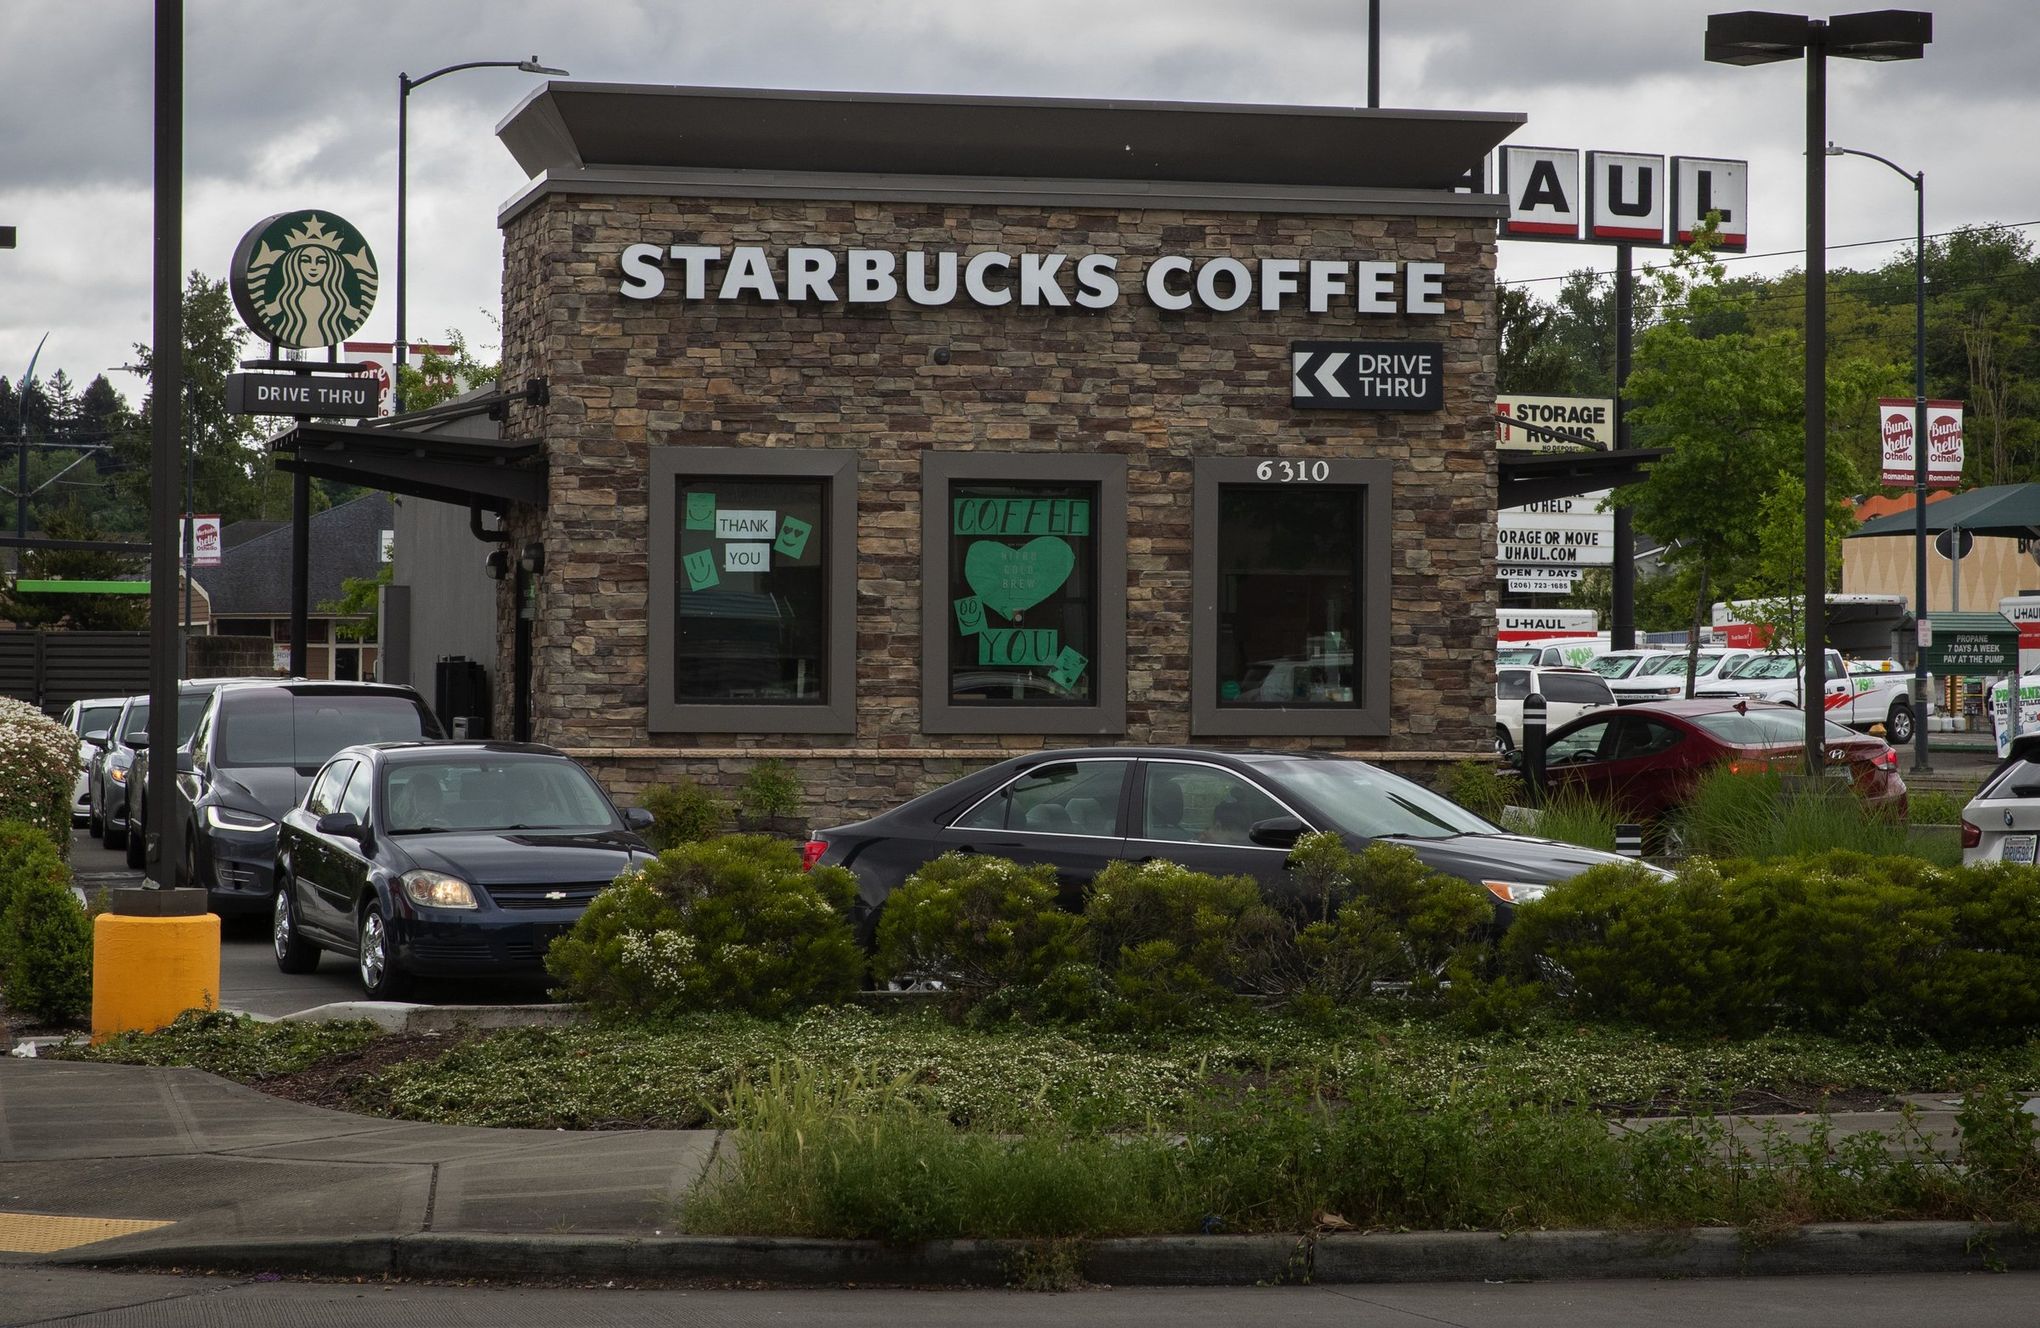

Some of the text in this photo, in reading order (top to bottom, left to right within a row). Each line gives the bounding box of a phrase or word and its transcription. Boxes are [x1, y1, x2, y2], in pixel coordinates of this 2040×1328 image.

[619, 243, 1445, 314] STARBUCKS COFFEE
[1359, 354, 1432, 374] DRIVE
[1359, 378, 1427, 398] THRU
[258, 386, 310, 402] DRIVE
[318, 388, 365, 404] THRU
[1517, 404, 1605, 424] STORAGE
[1888, 434, 1912, 452] hello
[1934, 436, 1962, 453] hello
[1885, 452, 1912, 461] Othello
[1931, 454, 1962, 462] Othello
[1256, 460, 1330, 482] 6310
[1883, 472, 1914, 480] Romanian
[1929, 474, 1960, 482] Romanian
[1542, 500, 1573, 513] HELP
[957, 500, 1088, 534] COFFEE
[720, 519, 768, 532] THANK
[1545, 532, 1560, 544] OR
[1565, 532, 1598, 545] MOVE
[729, 552, 761, 565] YOU
[1506, 547, 1577, 560] UHAUL.COM
[1501, 569, 1532, 577] OPEN
[1506, 619, 1566, 629] U-HAUL
[981, 630, 1053, 663] YOU
[1944, 655, 2004, 663] PAY AT THE PUMP
